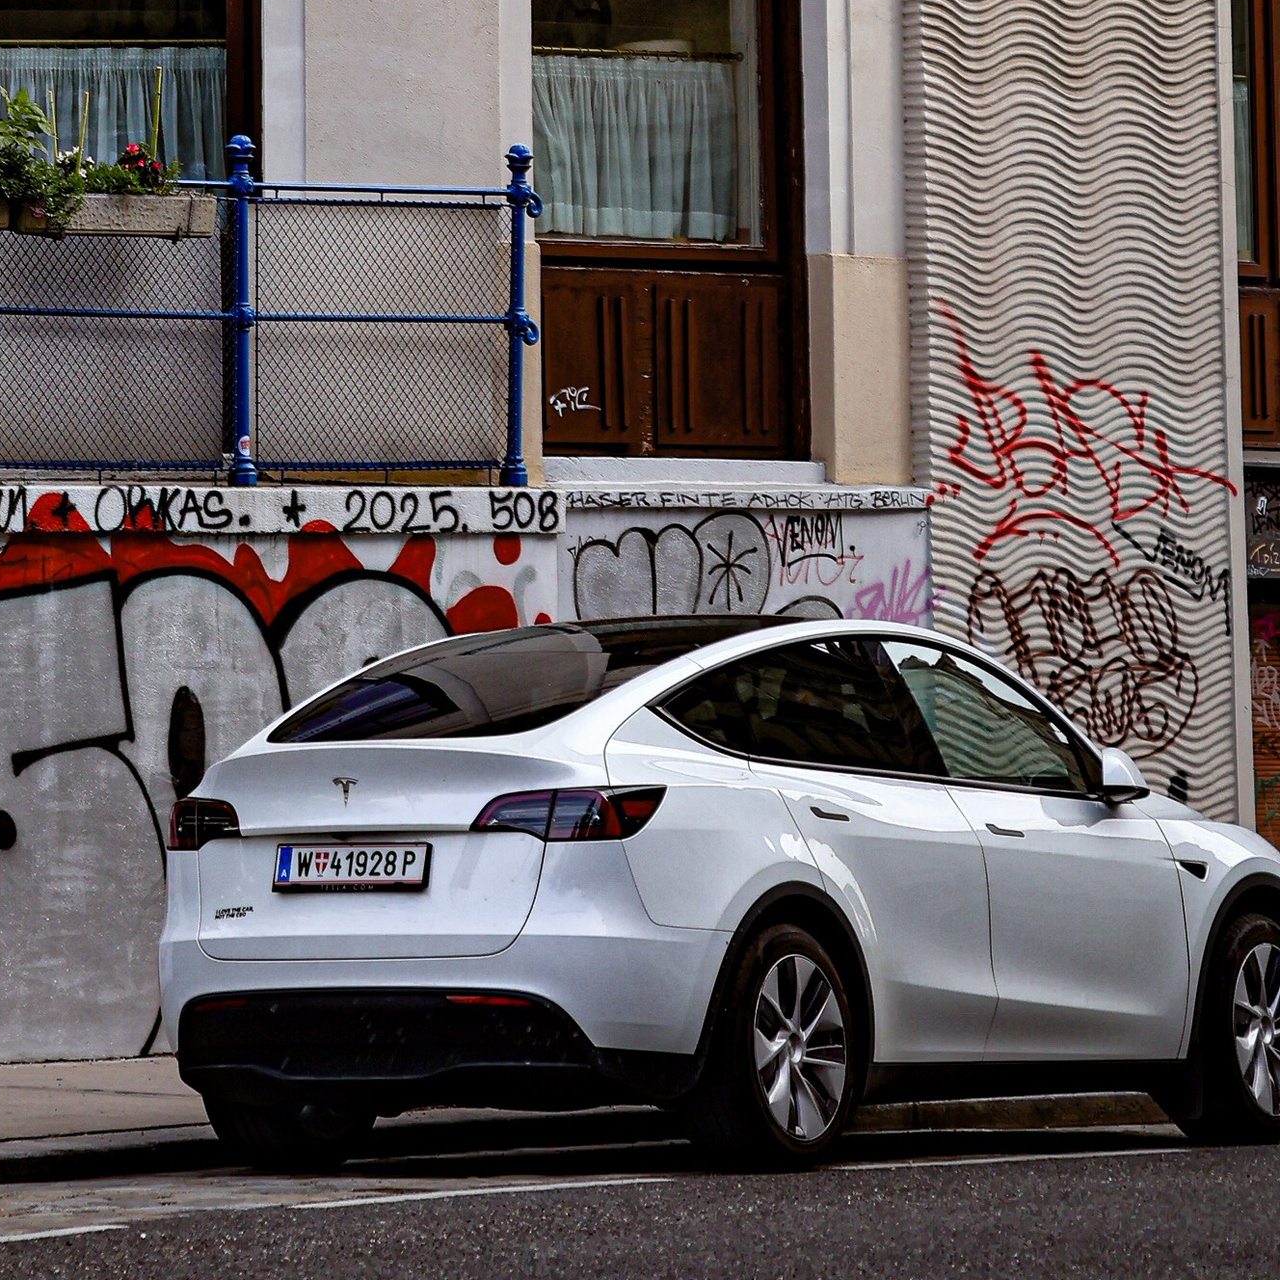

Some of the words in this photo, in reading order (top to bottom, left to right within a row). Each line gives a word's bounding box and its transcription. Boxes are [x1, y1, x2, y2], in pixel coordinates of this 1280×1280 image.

[489, 490, 560, 533] 508
[297, 850, 314, 877] W
[330, 850, 398, 877] 41928
[401, 850, 417, 876] P
